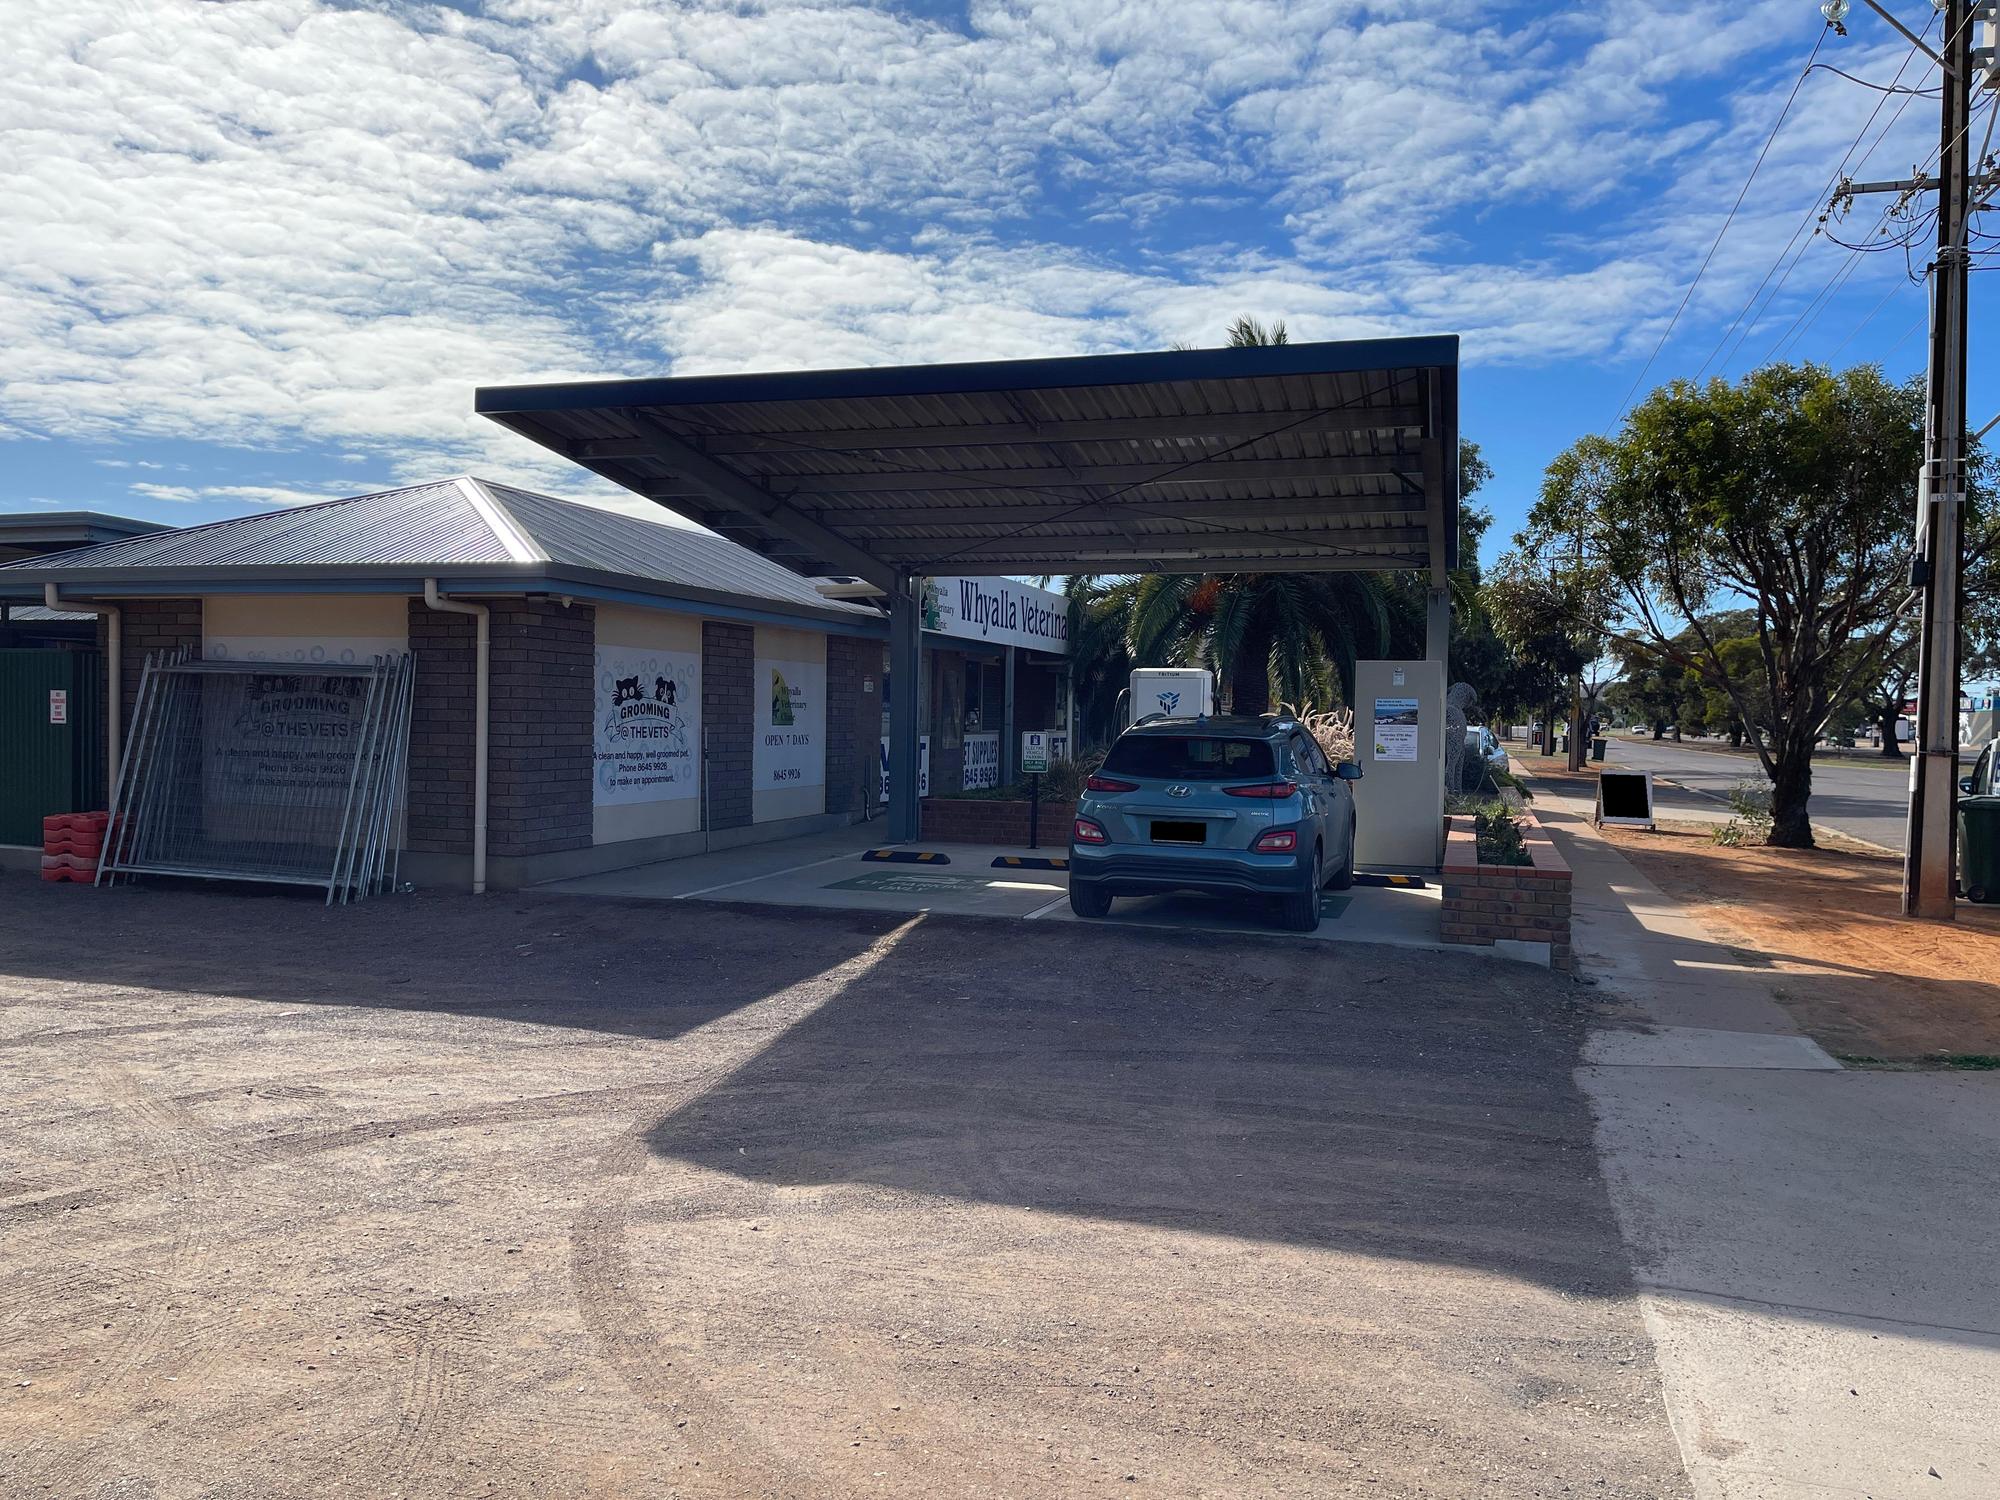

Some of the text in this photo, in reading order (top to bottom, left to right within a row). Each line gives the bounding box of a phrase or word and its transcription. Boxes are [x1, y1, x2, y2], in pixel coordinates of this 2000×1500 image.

[960, 579, 1068, 641] Whyalla Veterina
[260, 696, 351, 714] GROOMING
[620, 703, 670, 719] GROOMING
[765, 734, 809, 746] OPEN 7 DAYS
[305, 750, 324, 758] well
[599, 751, 614, 760] clean
[615, 751, 626, 760] and
[645, 751, 657, 759] well
[656, 750, 679, 760] groomed
[972, 740, 998, 765] SUPPLIES
[618, 762, 667, 772] Phone 8645 9926
[773, 768, 801, 781] 8645 9926
[964, 766, 997, 785] 645 9926
[610, 778, 616, 786] to
[617, 777, 634, 785] make
[634, 777, 641, 785] an
